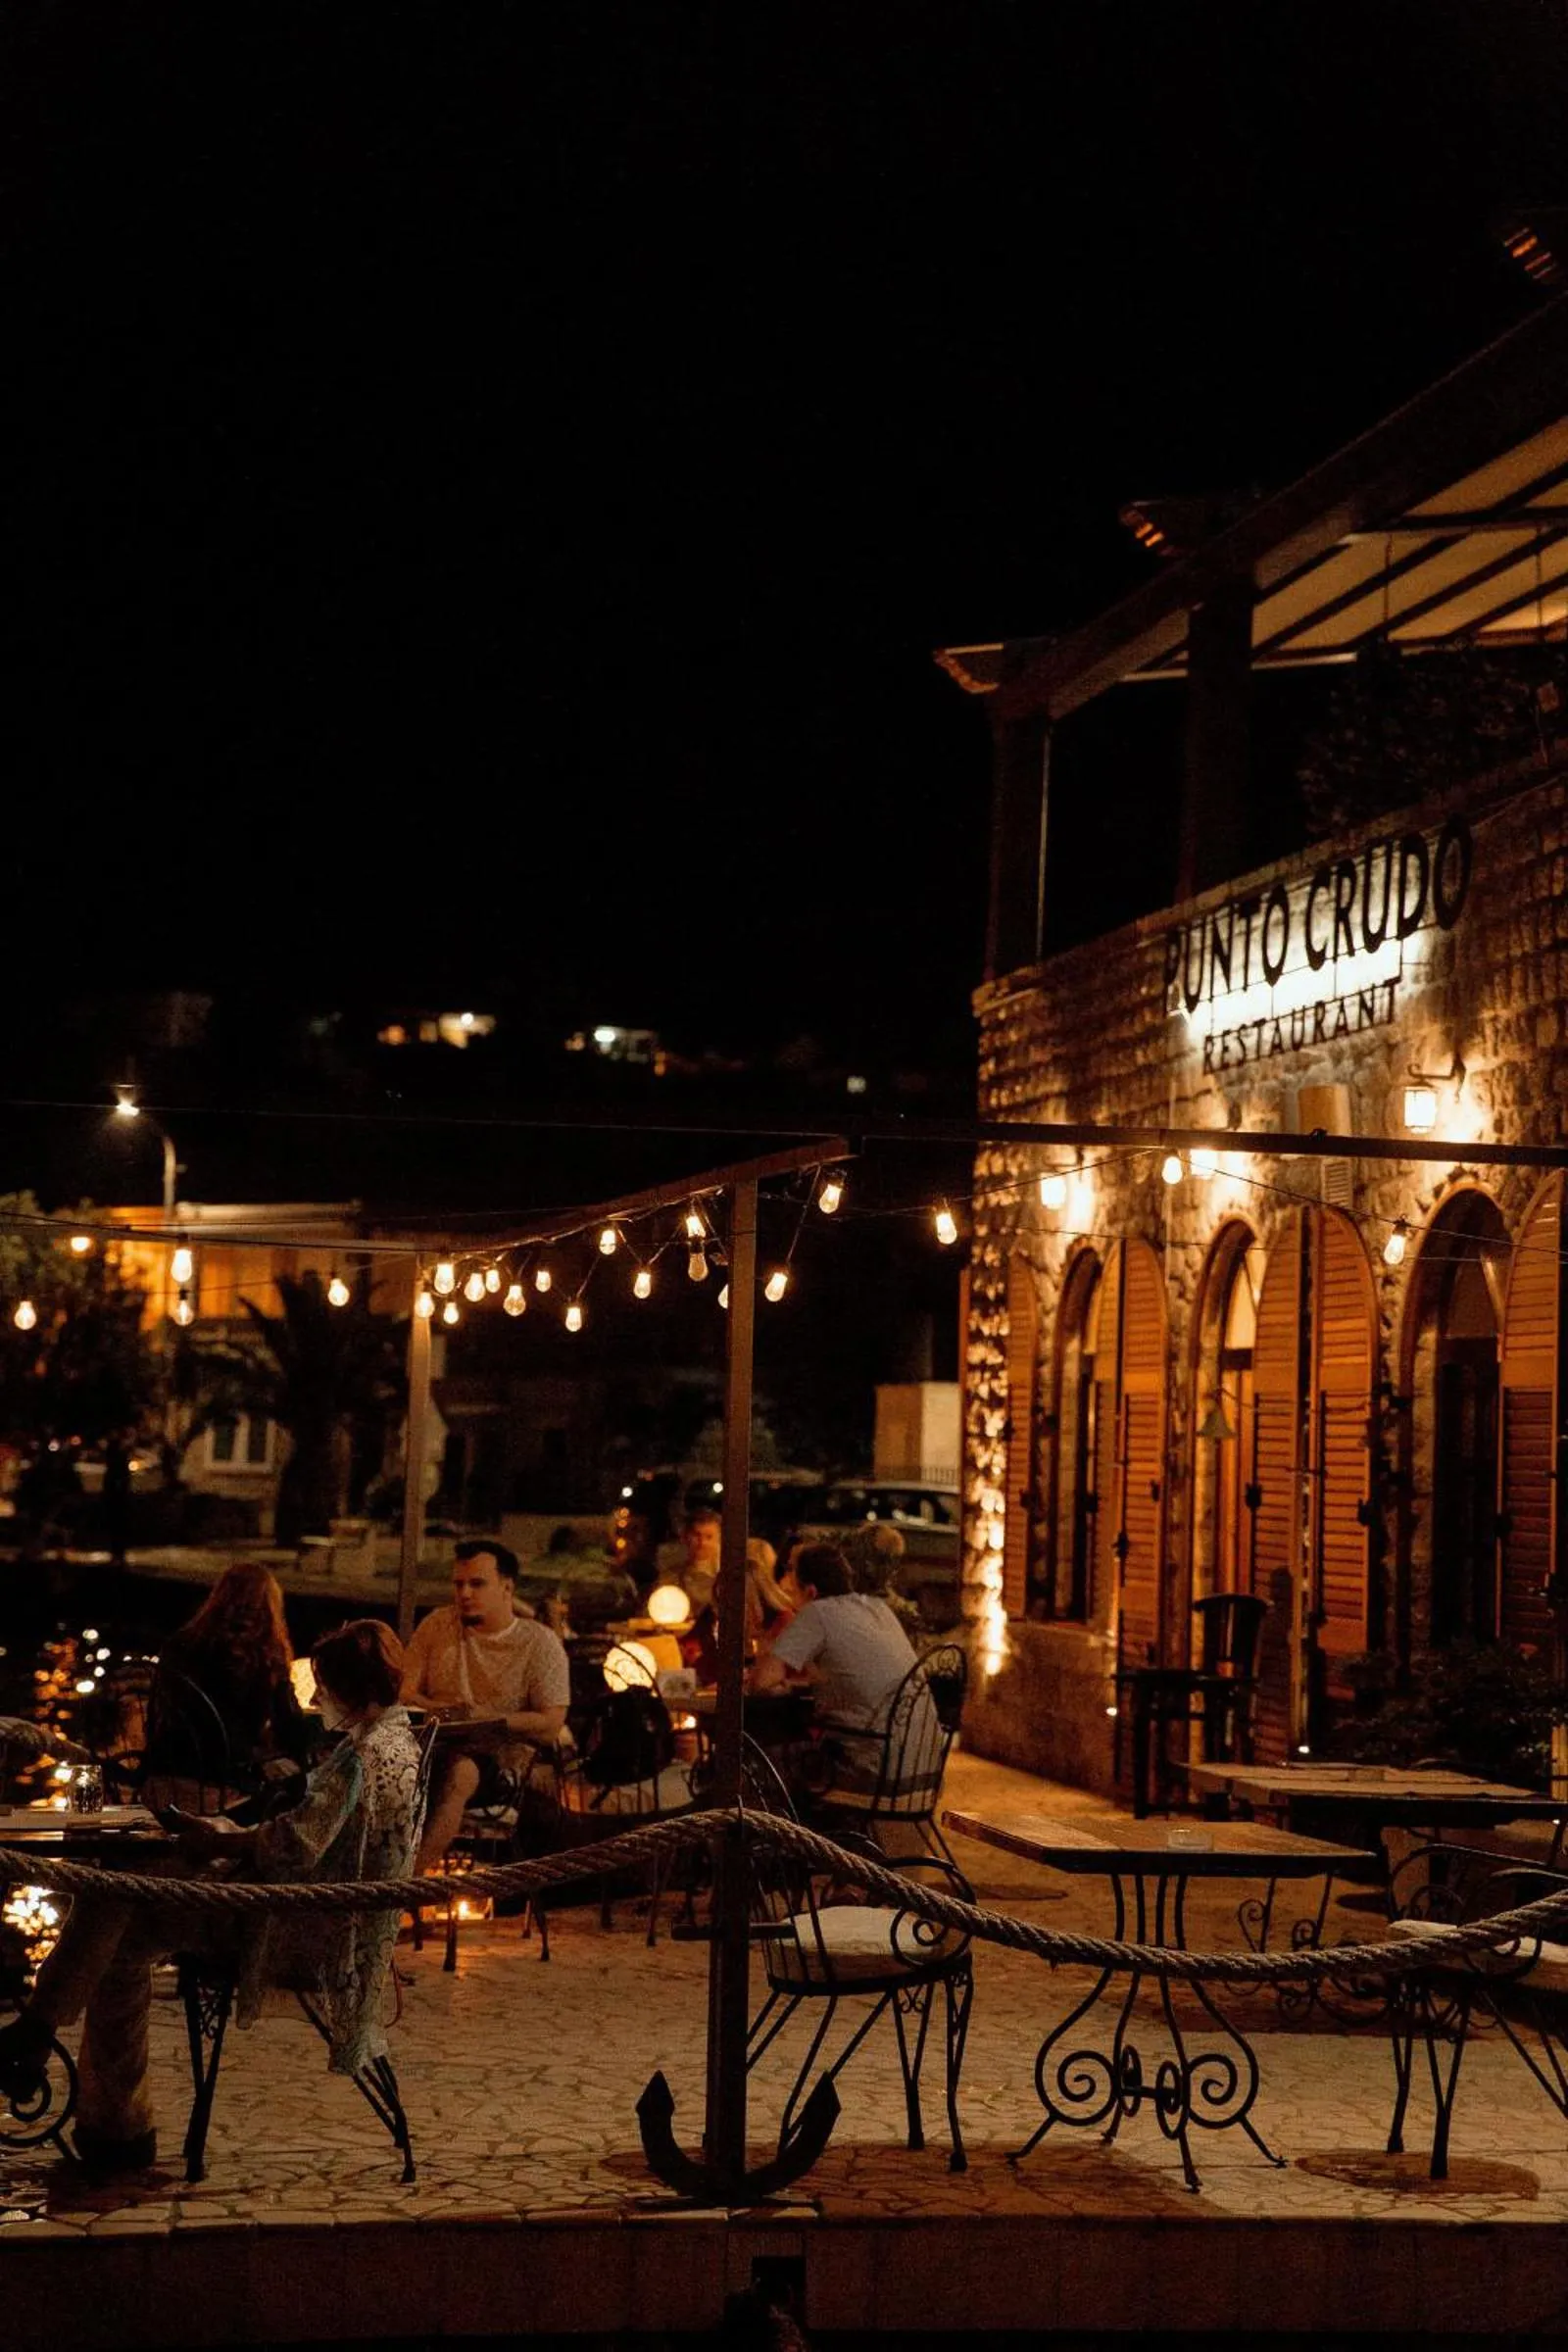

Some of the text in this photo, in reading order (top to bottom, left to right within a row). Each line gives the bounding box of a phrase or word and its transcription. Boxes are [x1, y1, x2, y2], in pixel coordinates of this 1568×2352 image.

[1163, 815, 1473, 1017] PUNTO CRUDO
[1203, 977, 1400, 1074] RESTAURANT
